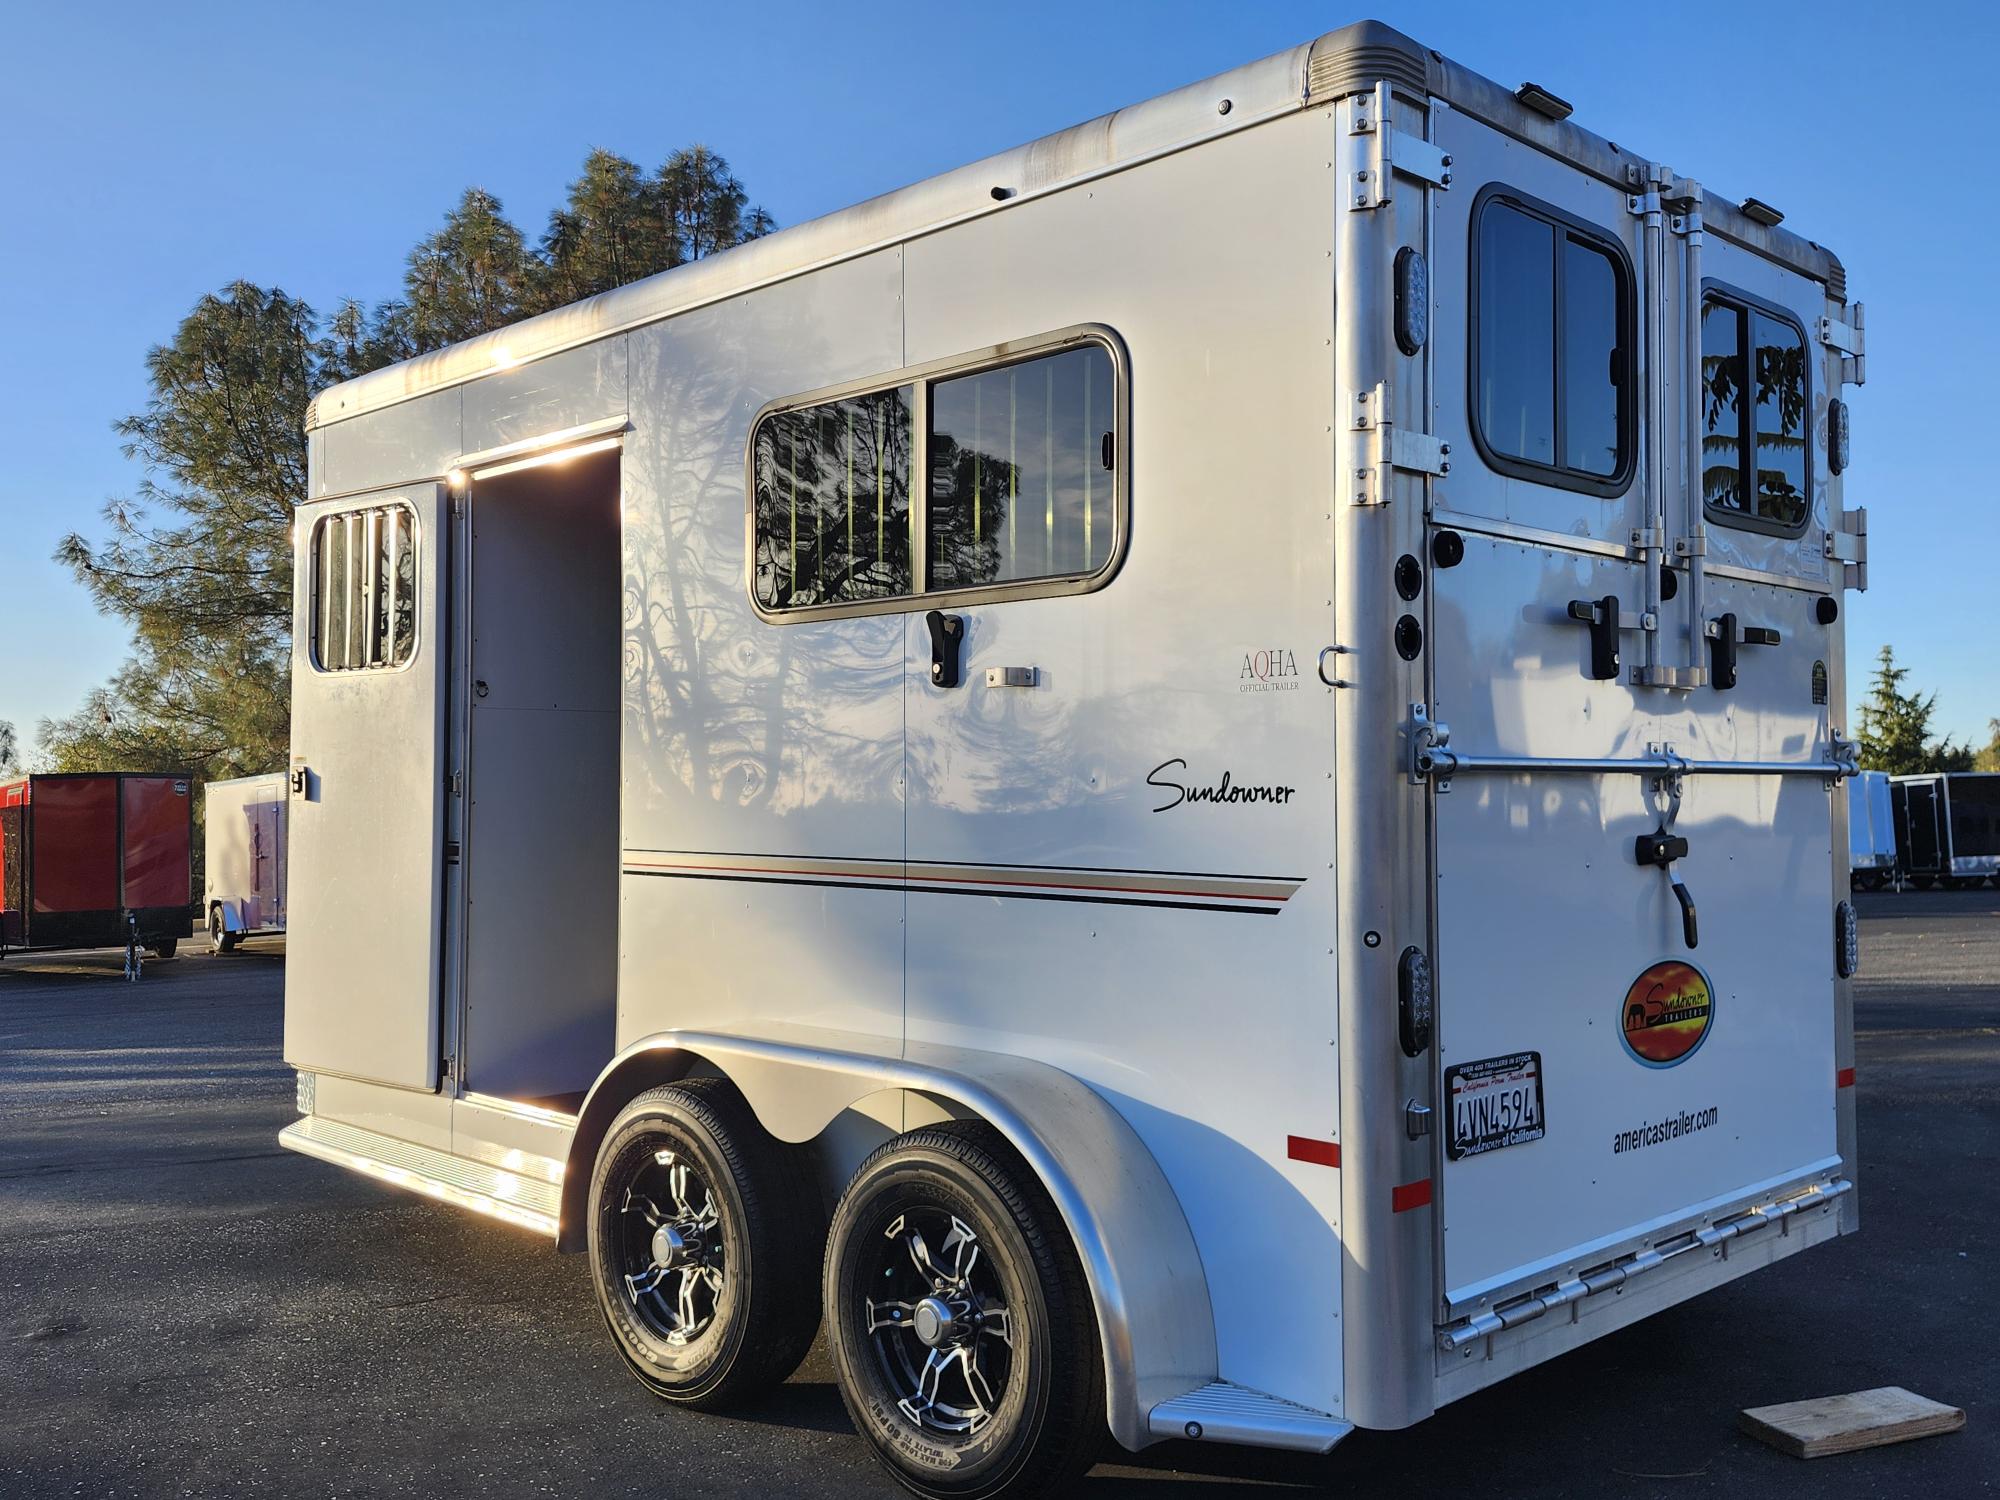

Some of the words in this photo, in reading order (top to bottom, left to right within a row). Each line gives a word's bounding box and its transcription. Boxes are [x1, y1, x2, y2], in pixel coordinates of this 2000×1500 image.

[1240, 649, 1299, 682] AQHA
[1240, 683, 1269, 693] OFFICIAL
[1271, 682, 1299, 691] TRAILER
[1146, 758, 1295, 813] Sundowner
[1646, 982, 1705, 1023] Sundowner
[1664, 1008, 1703, 1022] TRAILERS
[1459, 1066, 1474, 1074] OVER
[1474, 1064, 1484, 1072] 400
[1484, 1058, 1508, 1069] TRAILERS
[1508, 1057, 1515, 1065] IN
[1515, 1054, 1532, 1064] STOCK
[1462, 1080, 1489, 1093] California
[1506, 1072, 1525, 1081] Trailer
[1456, 1087, 1534, 1140] 4VN4594
[1455, 1136, 1502, 1160] Sundowner
[1502, 1134, 1509, 1146] of
[1510, 1126, 1543, 1145] California
[1613, 1105, 1718, 1155] americastrailer.com
[900, 1441, 919, 1457] LOAD
[919, 1452, 937, 1465] MAX
